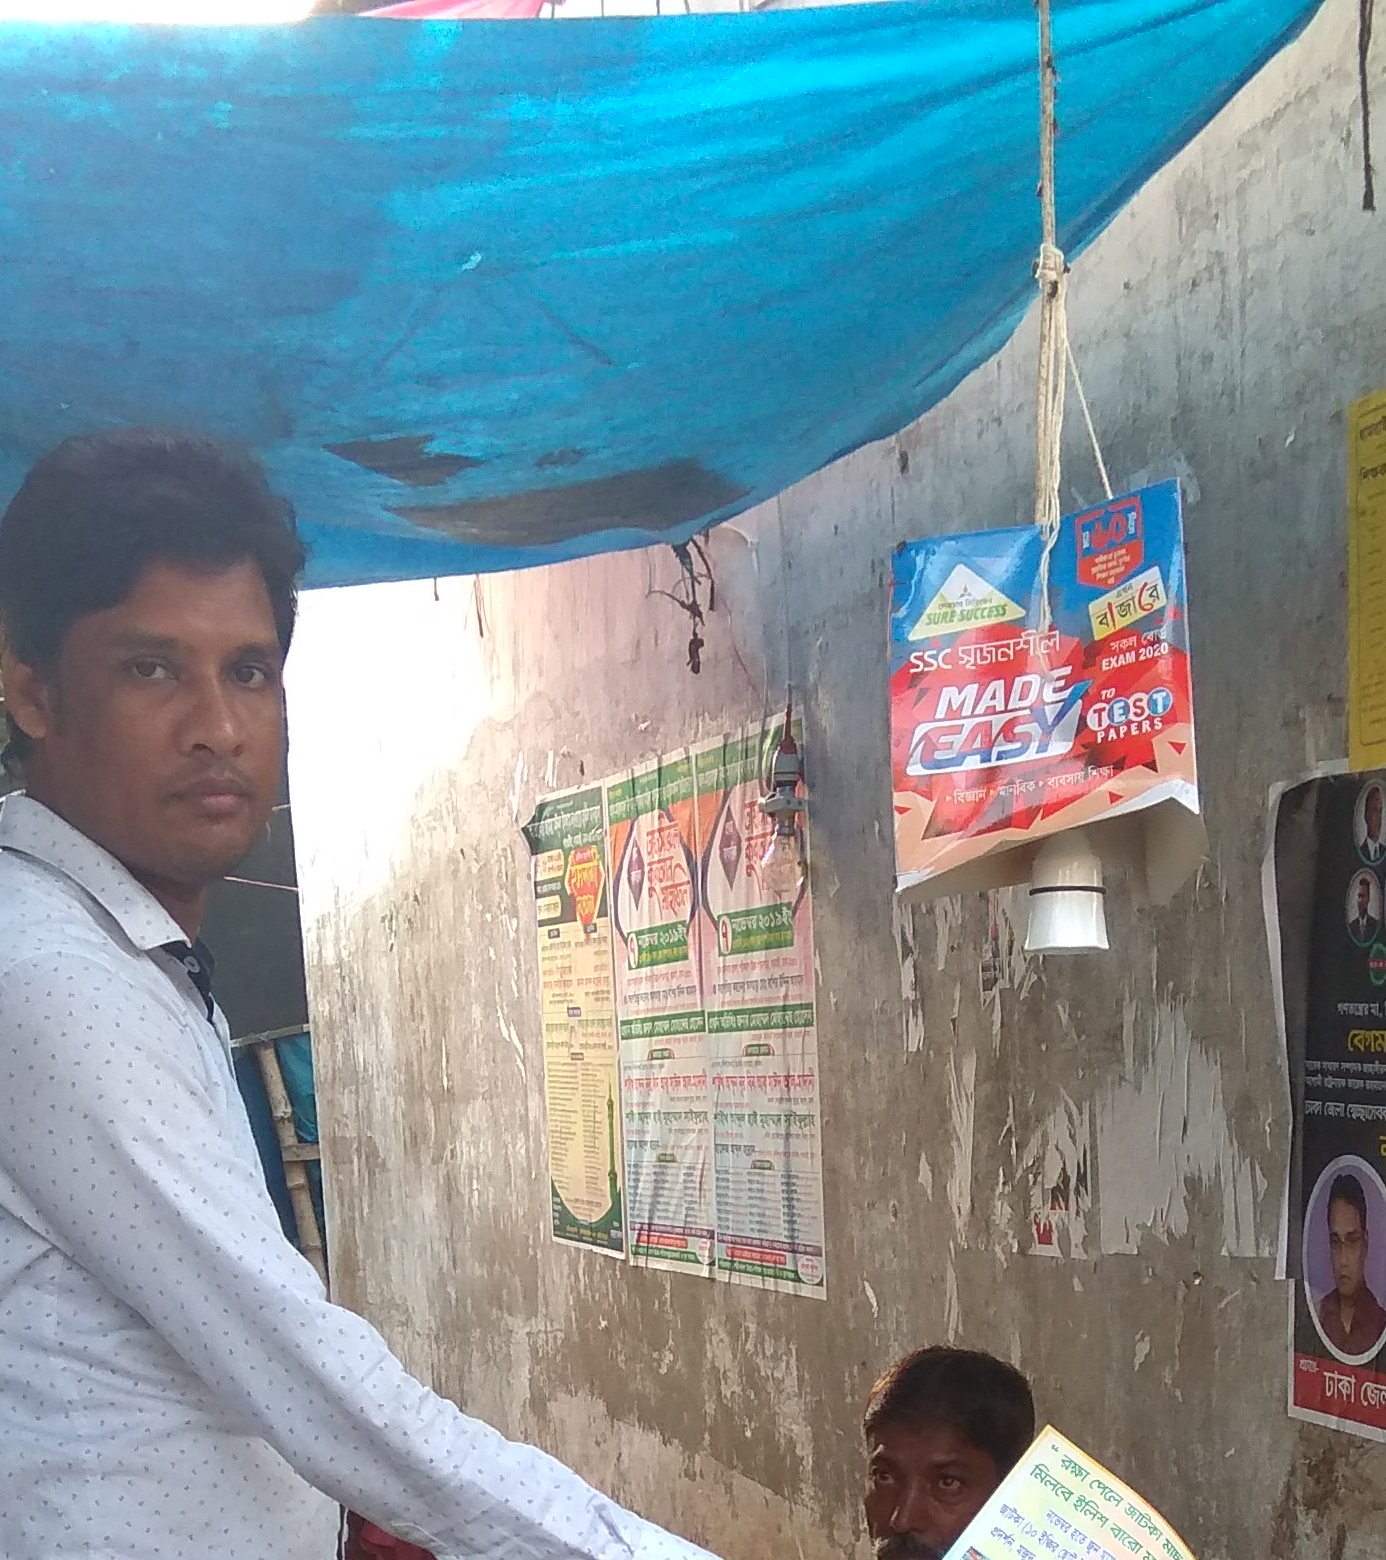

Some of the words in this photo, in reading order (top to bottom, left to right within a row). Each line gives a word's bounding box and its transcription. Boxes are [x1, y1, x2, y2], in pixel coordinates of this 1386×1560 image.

[925, 611, 956, 626] SURE
[958, 604, 1008, 622] SUCCESS
[910, 649, 953, 673] SSC
[1102, 651, 1136, 672] EXAM
[1139, 642, 1169, 662] 2020
[934, 665, 1072, 720] MADE
[1100, 687, 1116, 700] TO
[919, 679, 1093, 771] EASY
[1090, 689, 1169, 731] TEST
[1097, 717, 1164, 744] PAPERS
[1324, 1102, 1345, 1118] জেলা
[1323, 1370, 1355, 1404] ঢাকা
[1030, 1463, 1074, 1502] মিলবে
[1073, 1494, 1109, 1528] ইলিশ
[1110, 1523, 1143, 1554] বারো
[1061, 1454, 1089, 1482] রক্ষা
[1089, 1479, 1124, 1507] পেলে
[1125, 1502, 1163, 1541] জাটকা
